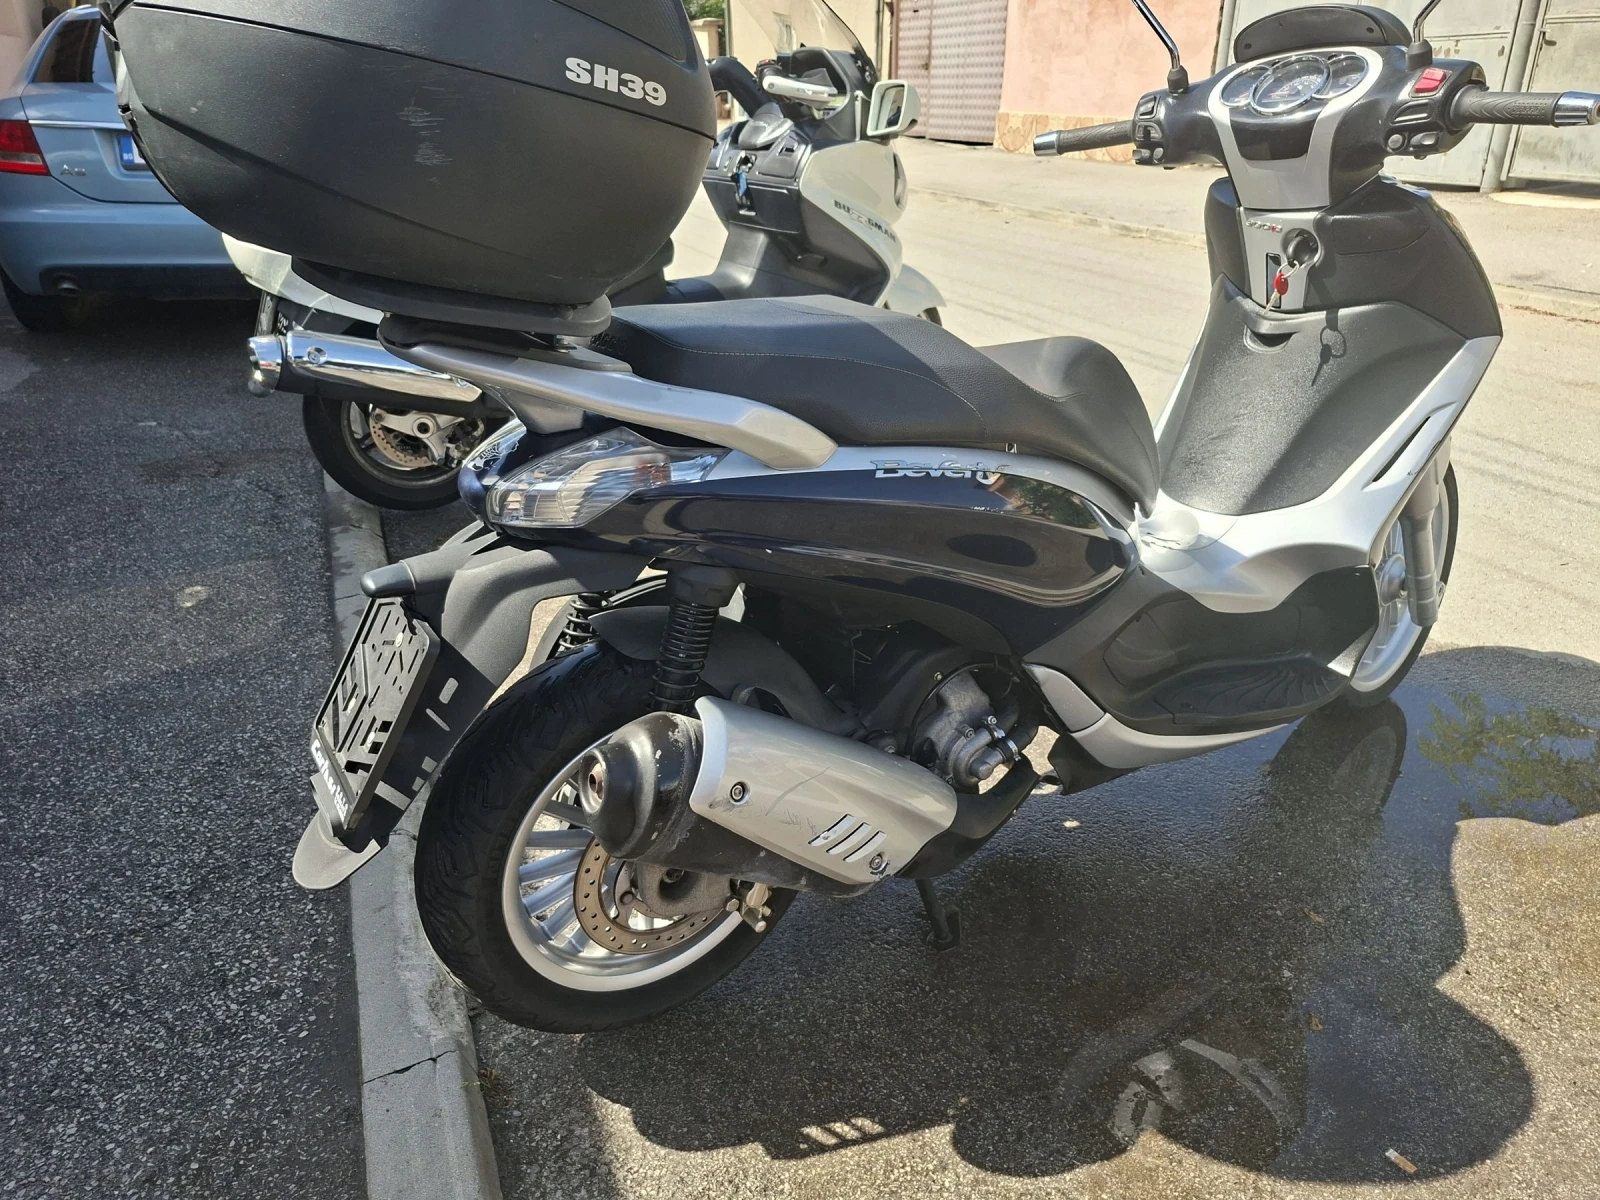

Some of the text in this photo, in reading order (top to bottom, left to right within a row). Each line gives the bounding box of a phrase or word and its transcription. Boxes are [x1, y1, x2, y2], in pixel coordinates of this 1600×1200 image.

[565, 57, 667, 106] SH39
[123, 152, 134, 160] BG
[870, 459, 1010, 485] Beverly
